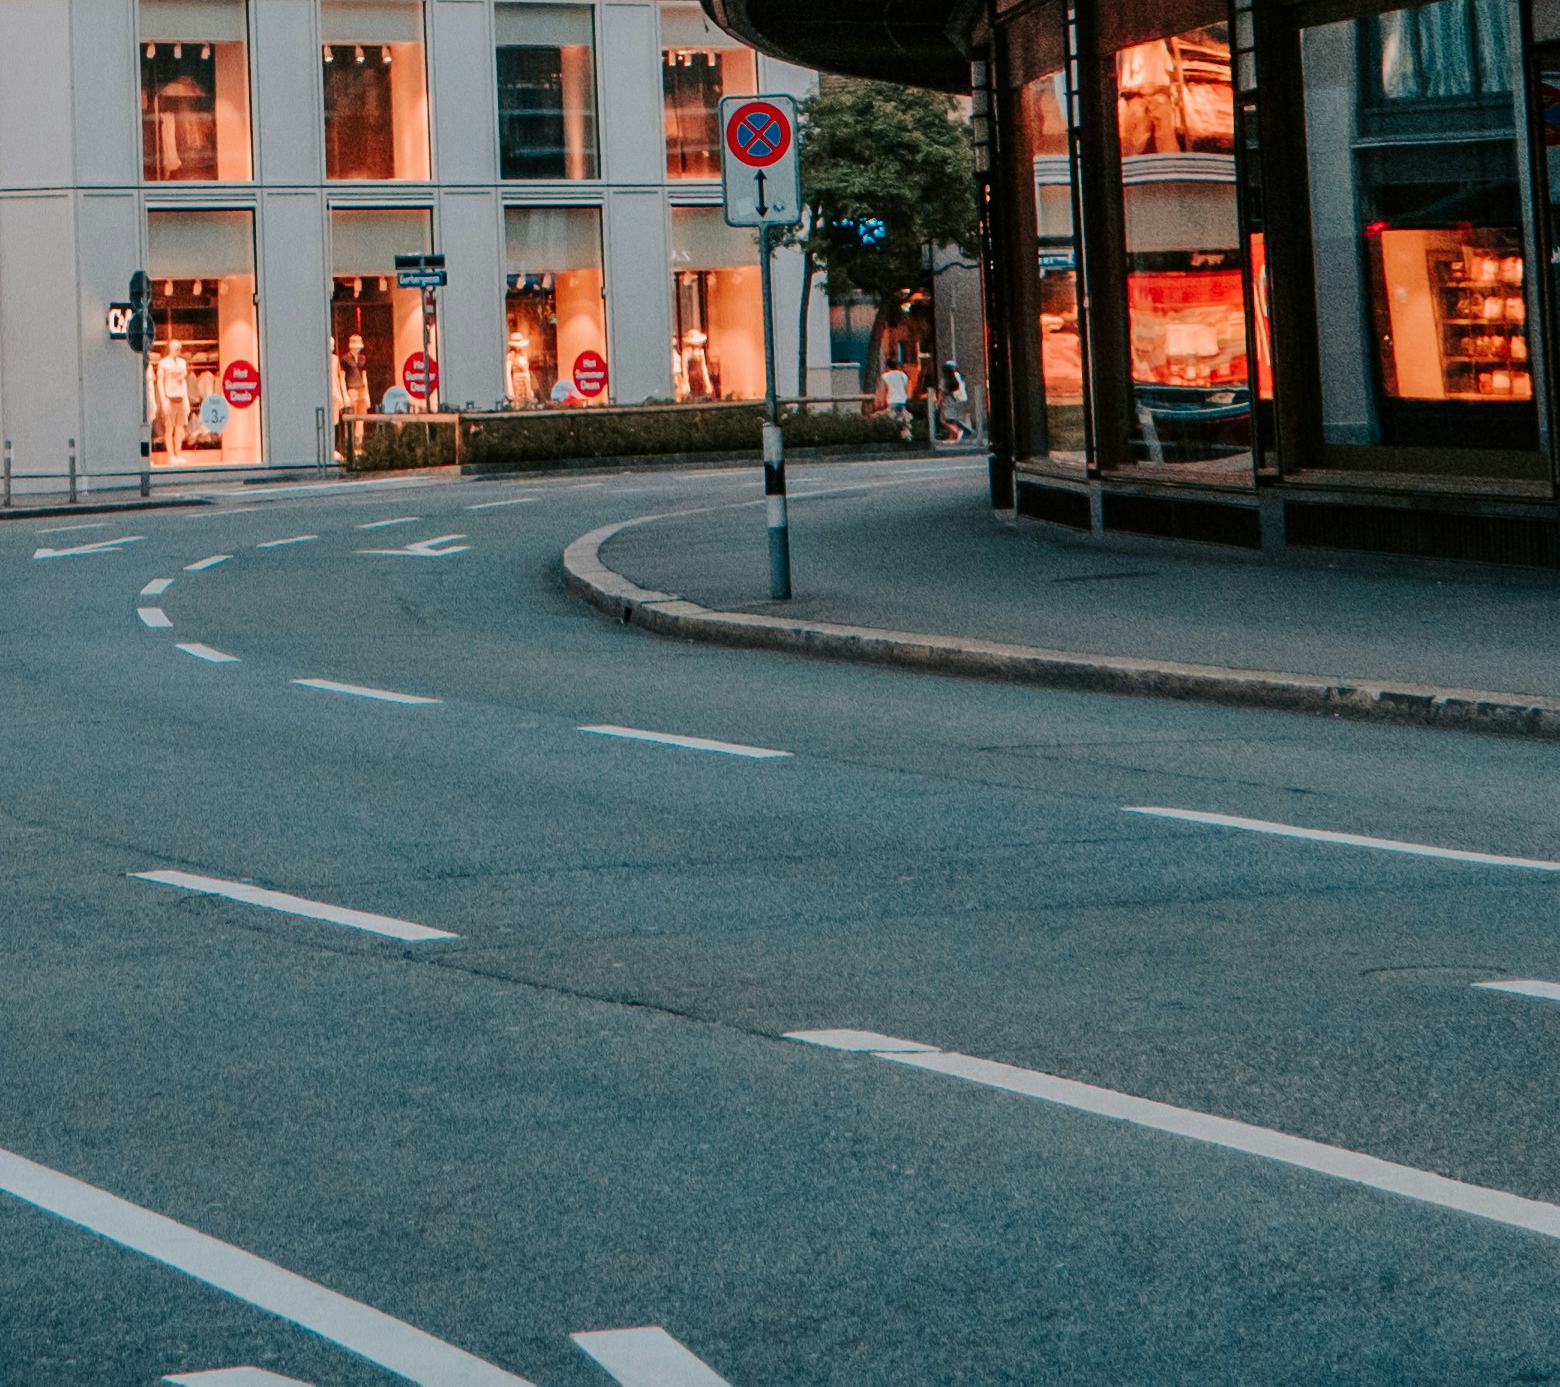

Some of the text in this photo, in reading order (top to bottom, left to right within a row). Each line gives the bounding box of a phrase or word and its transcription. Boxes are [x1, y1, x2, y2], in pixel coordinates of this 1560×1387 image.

[413, 359, 425, 370] Ho
[233, 368, 248, 379] Hot
[406, 371, 436, 381] Sumer
[225, 380, 257, 390] Summer
[230, 390, 252, 402] Deals
